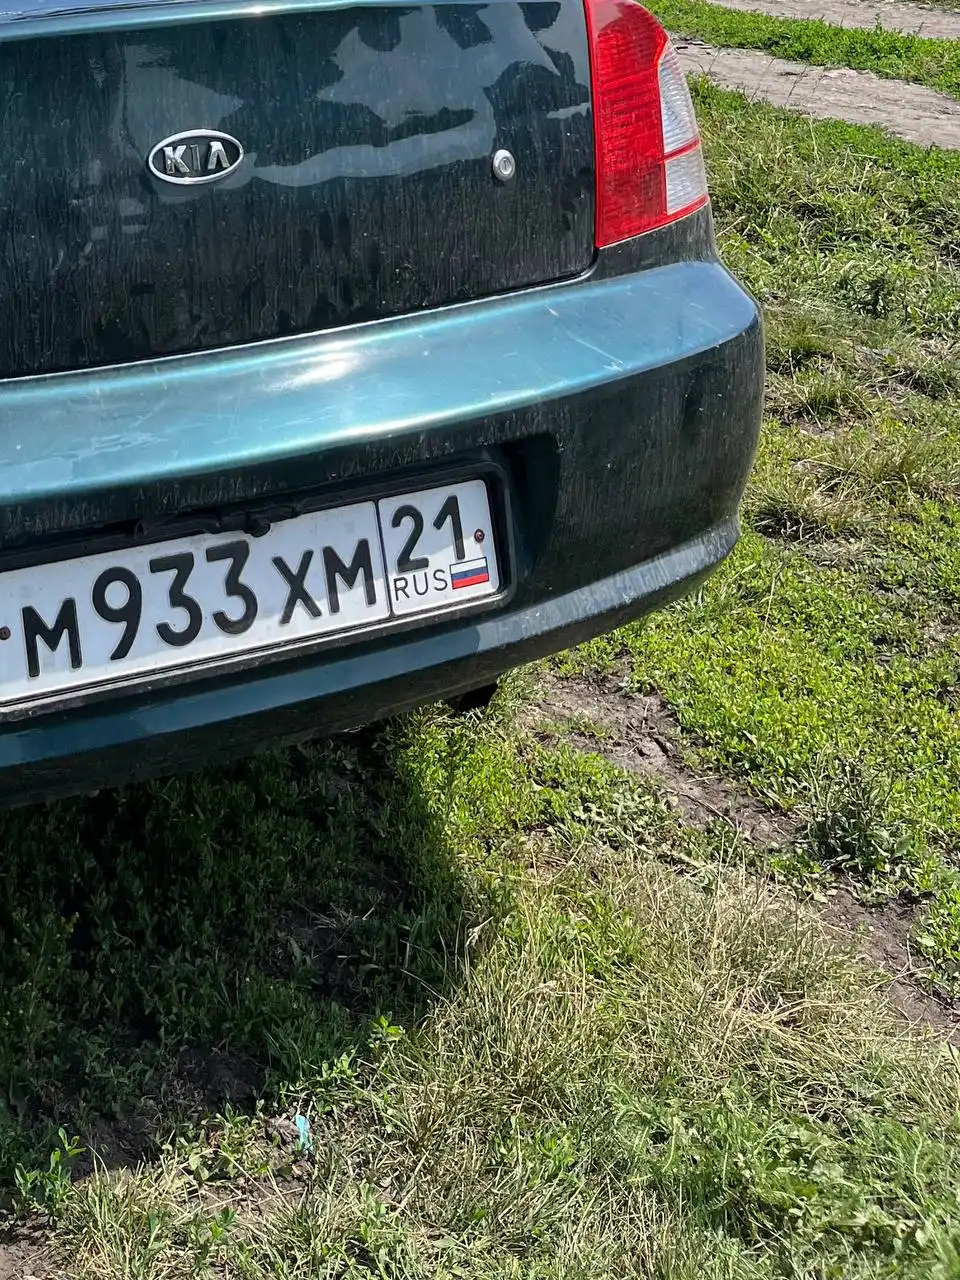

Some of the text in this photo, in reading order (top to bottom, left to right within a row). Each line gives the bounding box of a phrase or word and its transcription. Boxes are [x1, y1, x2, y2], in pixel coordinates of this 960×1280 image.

[163, 140, 229, 177] KIA
[390, 495, 466, 573] 21
[394, 568, 448, 602] RUS
